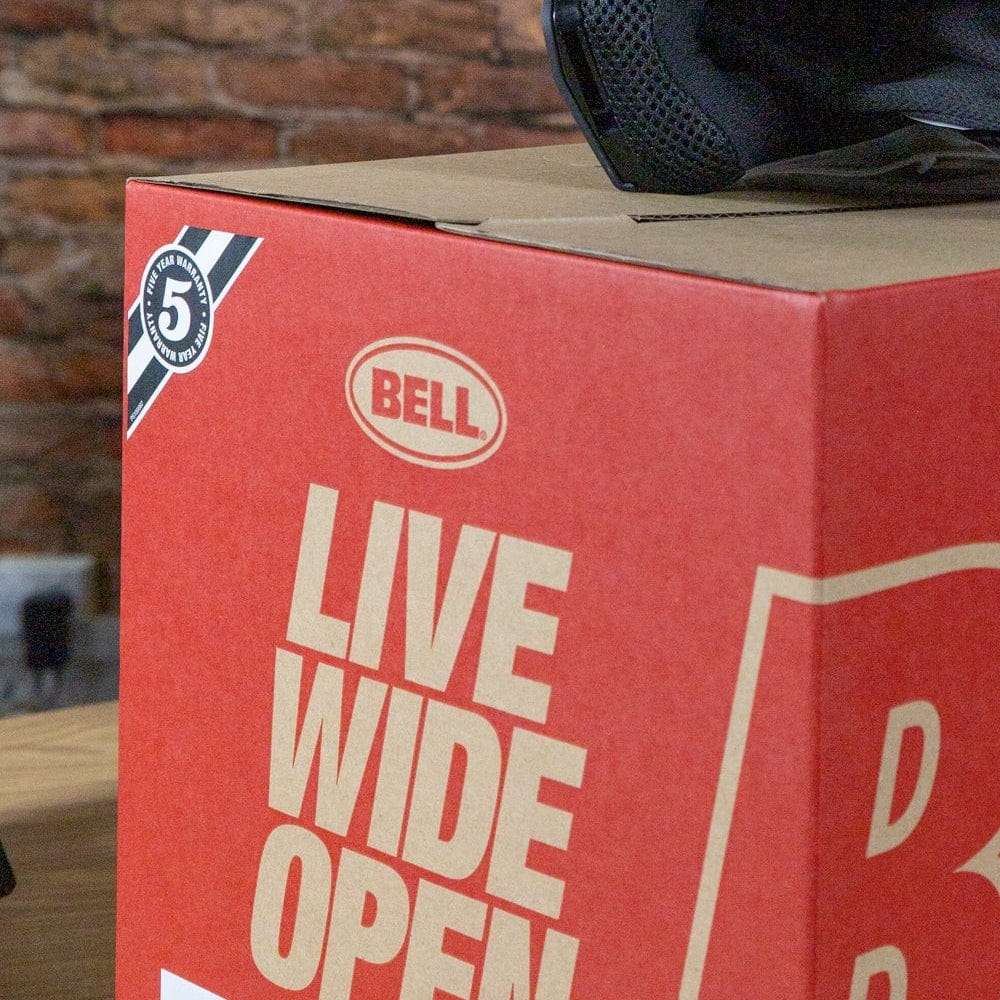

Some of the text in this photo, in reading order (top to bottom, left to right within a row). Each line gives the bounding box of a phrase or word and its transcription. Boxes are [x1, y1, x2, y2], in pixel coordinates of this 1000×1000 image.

[146, 254, 208, 305] FIVE YEAR WARRANTY
[158, 276, 192, 342] 5
[146, 312, 207, 363] FIVE YEAR WARRANTY
[370, 367, 481, 440] BELL
[285, 483, 573, 724] LIVE
[267, 647, 587, 919] WIDE
